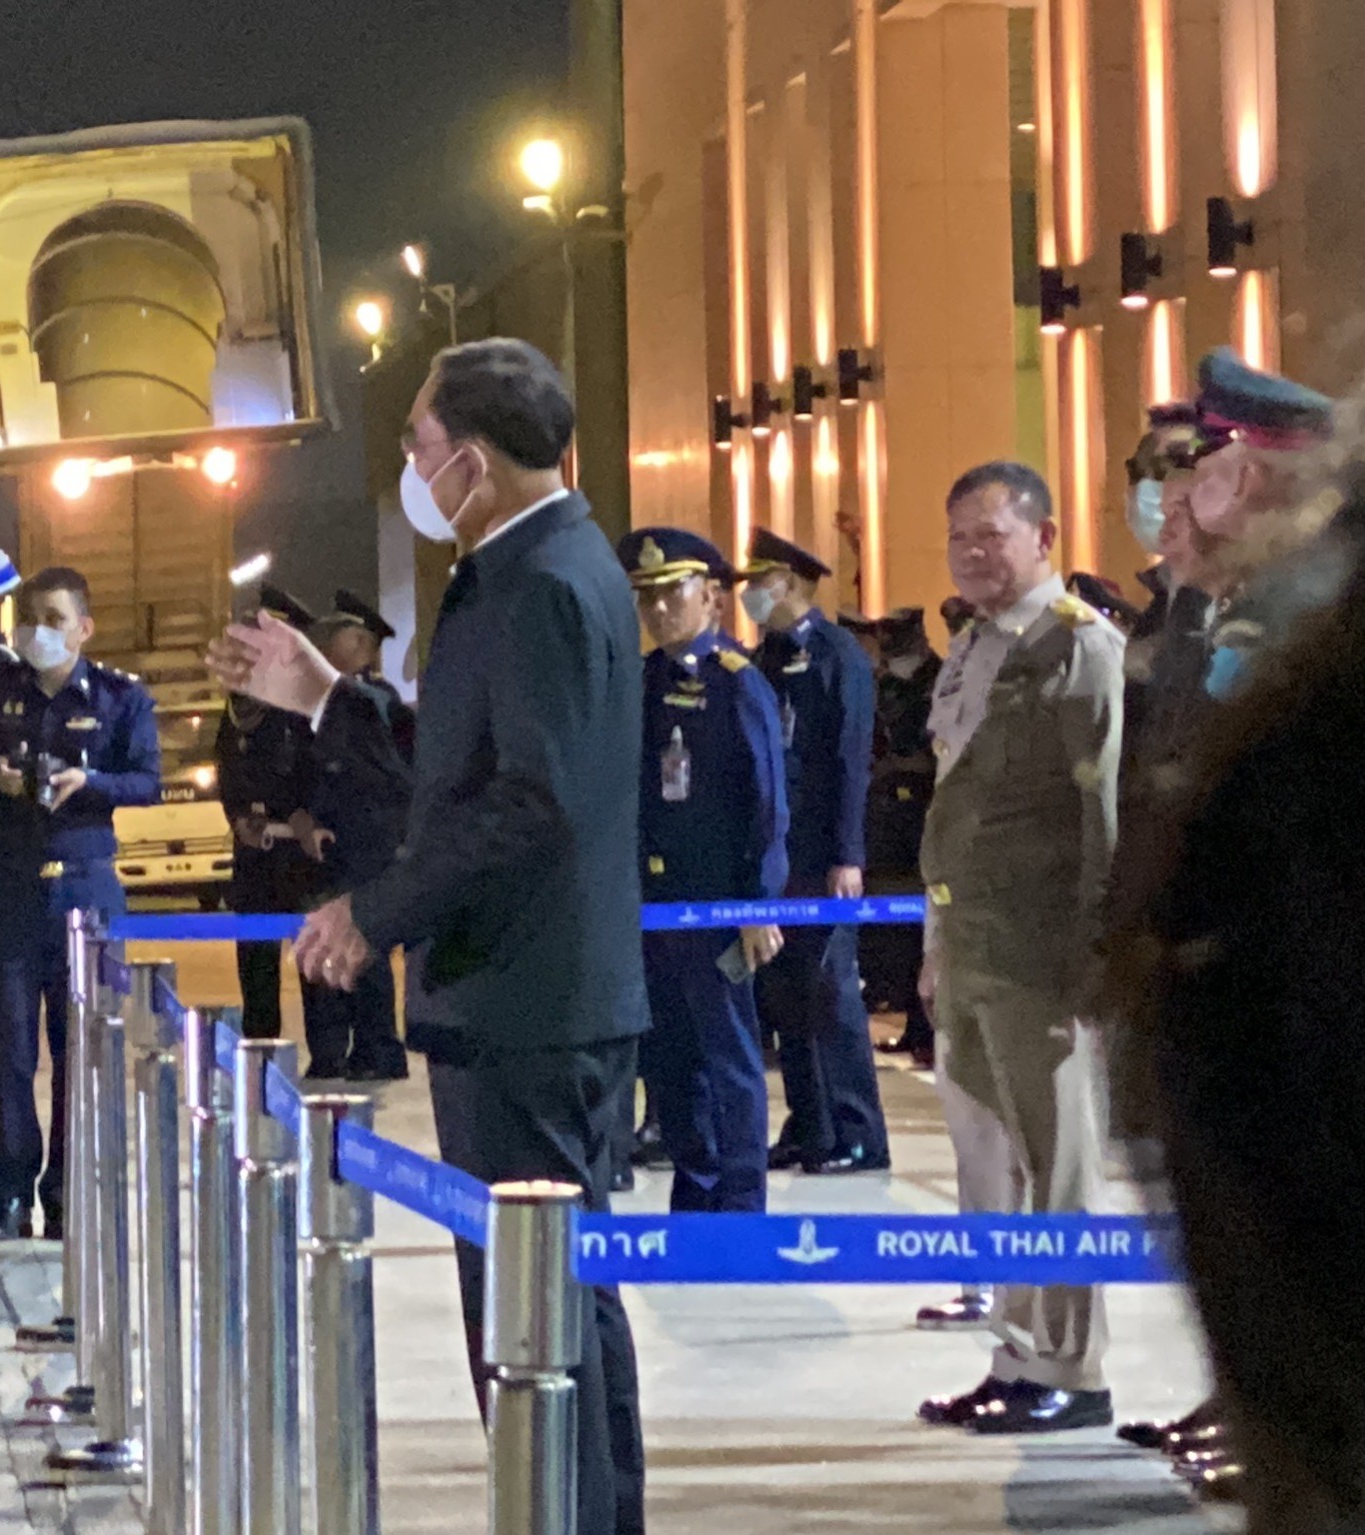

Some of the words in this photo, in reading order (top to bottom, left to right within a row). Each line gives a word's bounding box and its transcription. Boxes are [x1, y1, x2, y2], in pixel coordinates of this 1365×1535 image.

[877, 1230, 978, 1258] ROYAL
[988, 1230, 1065, 1257] THAI
[1077, 1230, 1131, 1257] AIR
